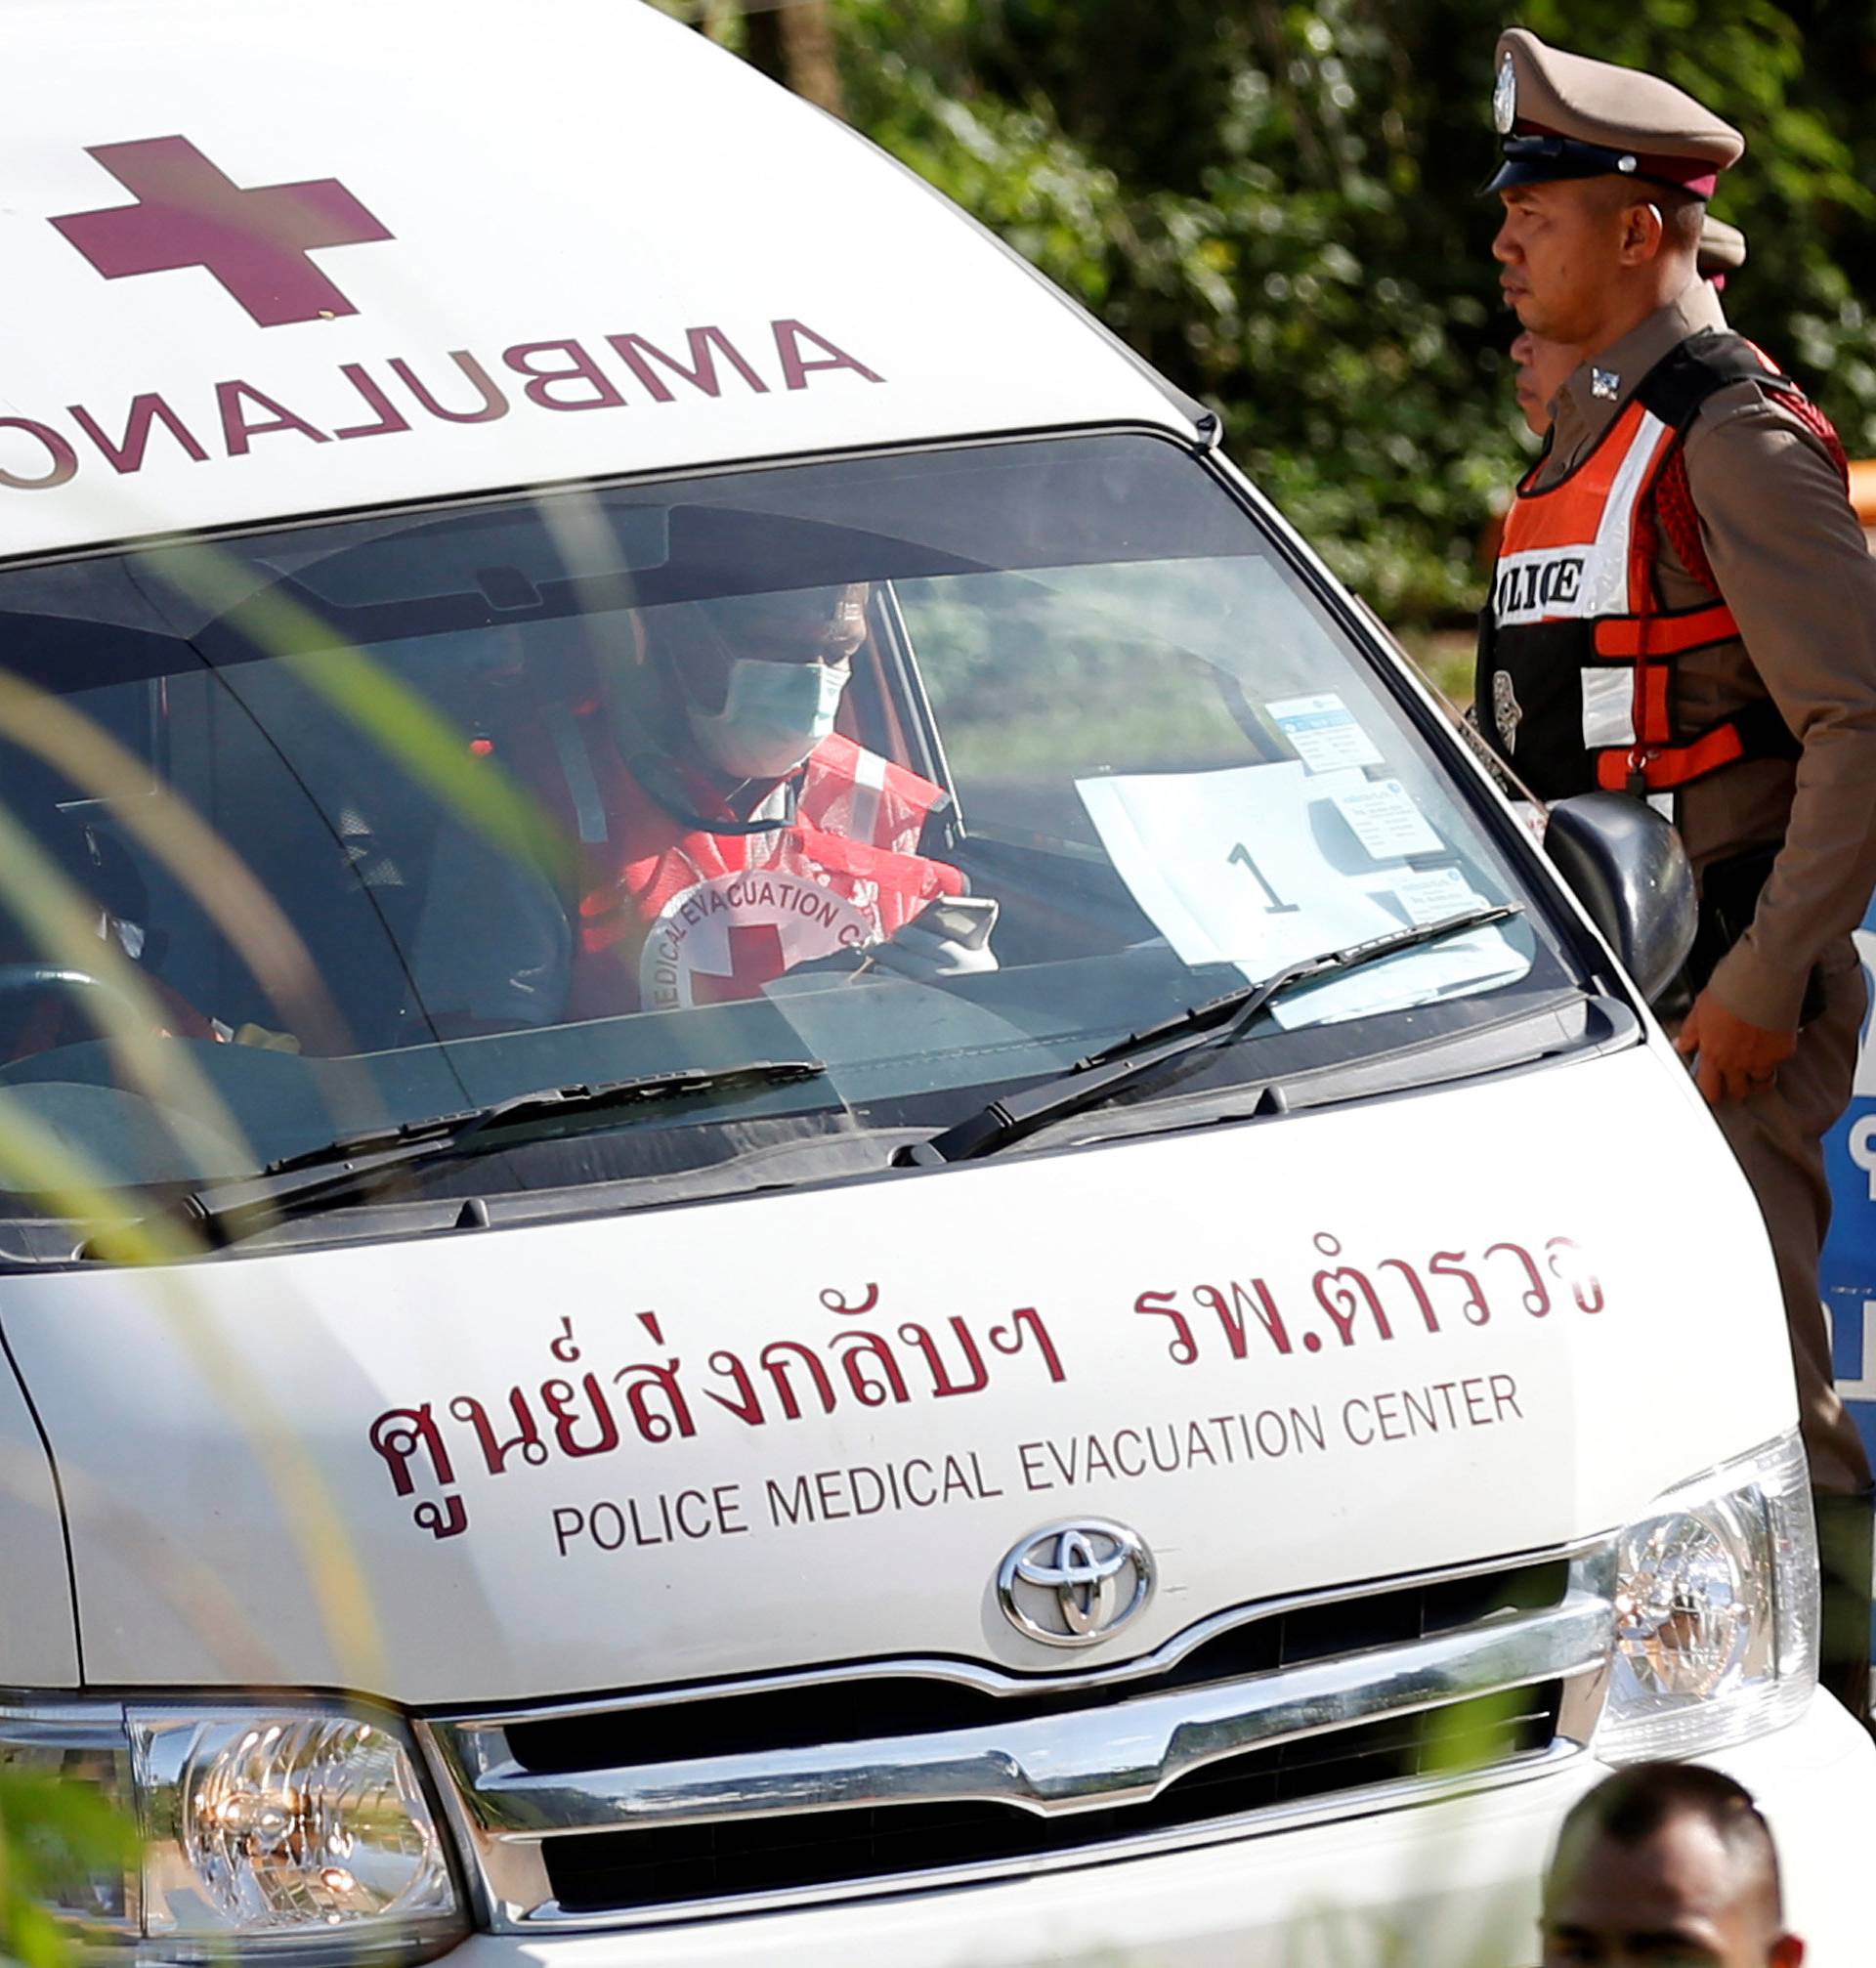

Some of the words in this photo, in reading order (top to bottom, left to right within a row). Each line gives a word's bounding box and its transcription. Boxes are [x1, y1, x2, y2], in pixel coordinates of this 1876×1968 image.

[653, 919, 687, 1009] EDICAL
[680, 881, 839, 927] EVACUATION
[1225, 842, 1301, 914] 1
[368, 1282, 1067, 1540] ศูนย์ส่งกลับฯ
[552, 1484, 747, 1556] POLICE
[765, 1450, 1003, 1526] MEDICAL
[1018, 1403, 1327, 1491] EVACUATION
[1342, 1373, 1523, 1446] CENTER
